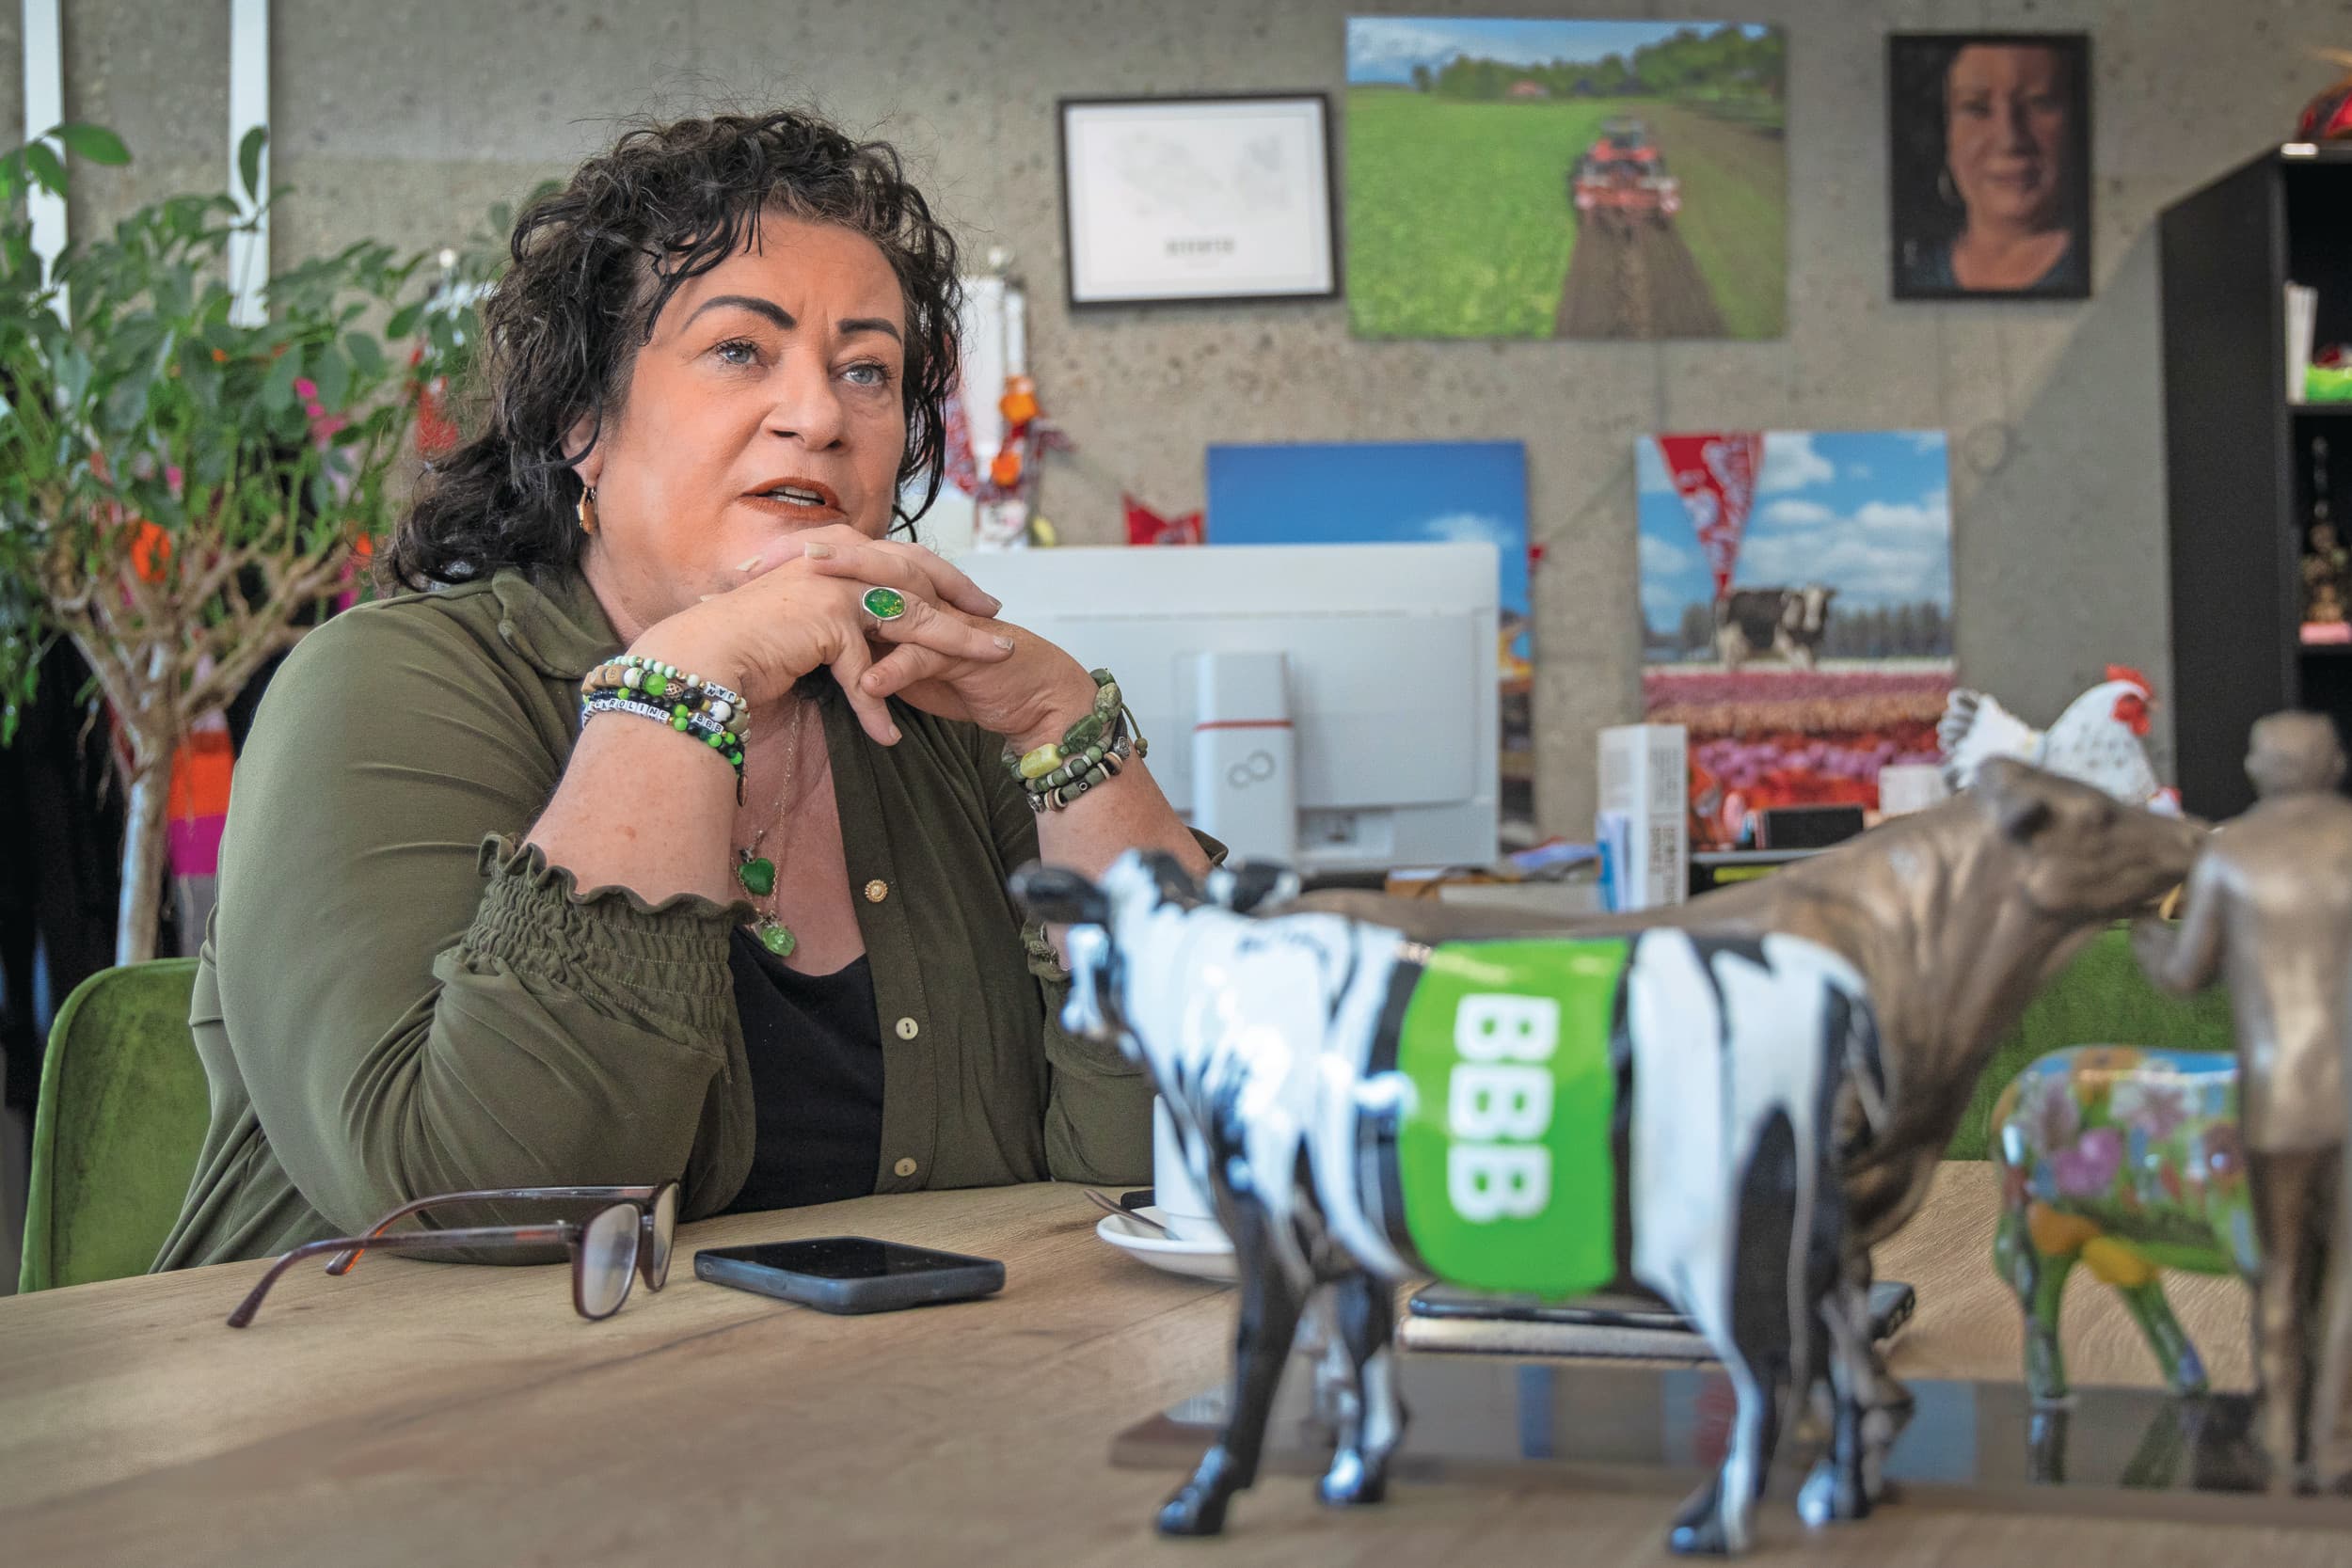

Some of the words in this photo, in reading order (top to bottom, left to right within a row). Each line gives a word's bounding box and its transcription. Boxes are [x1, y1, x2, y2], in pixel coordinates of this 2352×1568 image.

[596, 698, 667, 720] CAROLINE
[696, 714, 723, 733] BBB
[1447, 992, 1561, 1225] BBB
